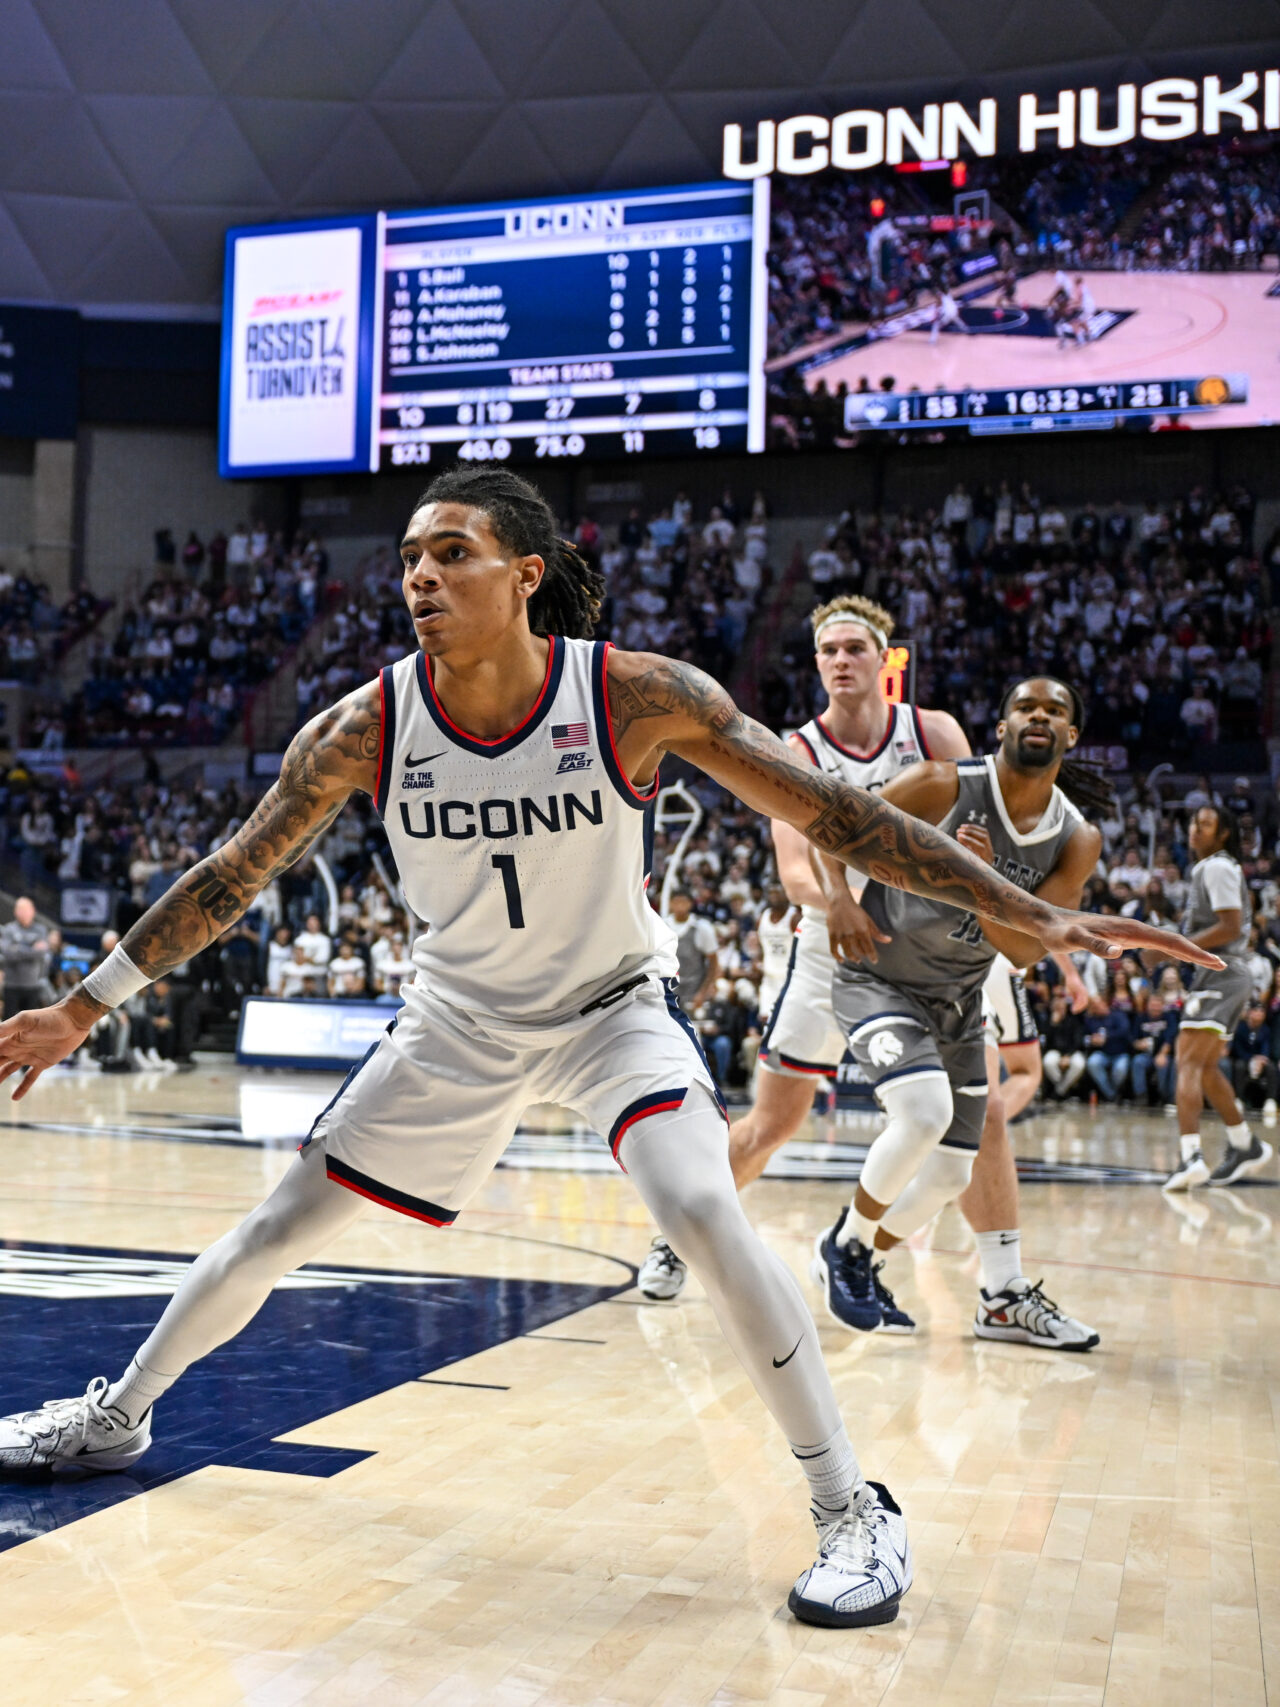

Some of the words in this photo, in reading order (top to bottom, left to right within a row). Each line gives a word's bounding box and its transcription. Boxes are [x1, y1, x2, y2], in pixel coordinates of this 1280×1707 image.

[722, 98, 997, 181] UCONN
[504, 201, 624, 239] UCONN
[607, 252, 630, 272] 10
[649, 249, 660, 268] 1
[683, 247, 698, 266] 2
[721, 244, 733, 263] 1
[648, 269, 660, 288] 1
[721, 263, 733, 282] 1
[647, 288, 659, 308] 1
[718, 283, 733, 302] 2
[645, 308, 660, 328] 2
[720, 302, 731, 322] 1
[647, 328, 658, 347] 1
[719, 322, 731, 342] 1
[247, 364, 342, 400] TURNOVER
[509, 365, 559, 386] TEAM
[560, 361, 615, 384] STATS
[397, 406, 426, 428] 10
[544, 397, 576, 421] 27
[624, 392, 642, 416] 7
[1004, 389, 1081, 416] 16:32
[1129, 383, 1164, 408] 25
[457, 437, 512, 461] 40.0
[623, 430, 645, 453] 11
[557, 760, 594, 771] EAST
[560, 752, 587, 763] BIG
[401, 780, 436, 790] CHANGE
[404, 772, 416, 782] BE
[417, 771, 433, 782] THE
[398, 789, 604, 840] UCONN
[491, 853, 526, 929] 1
